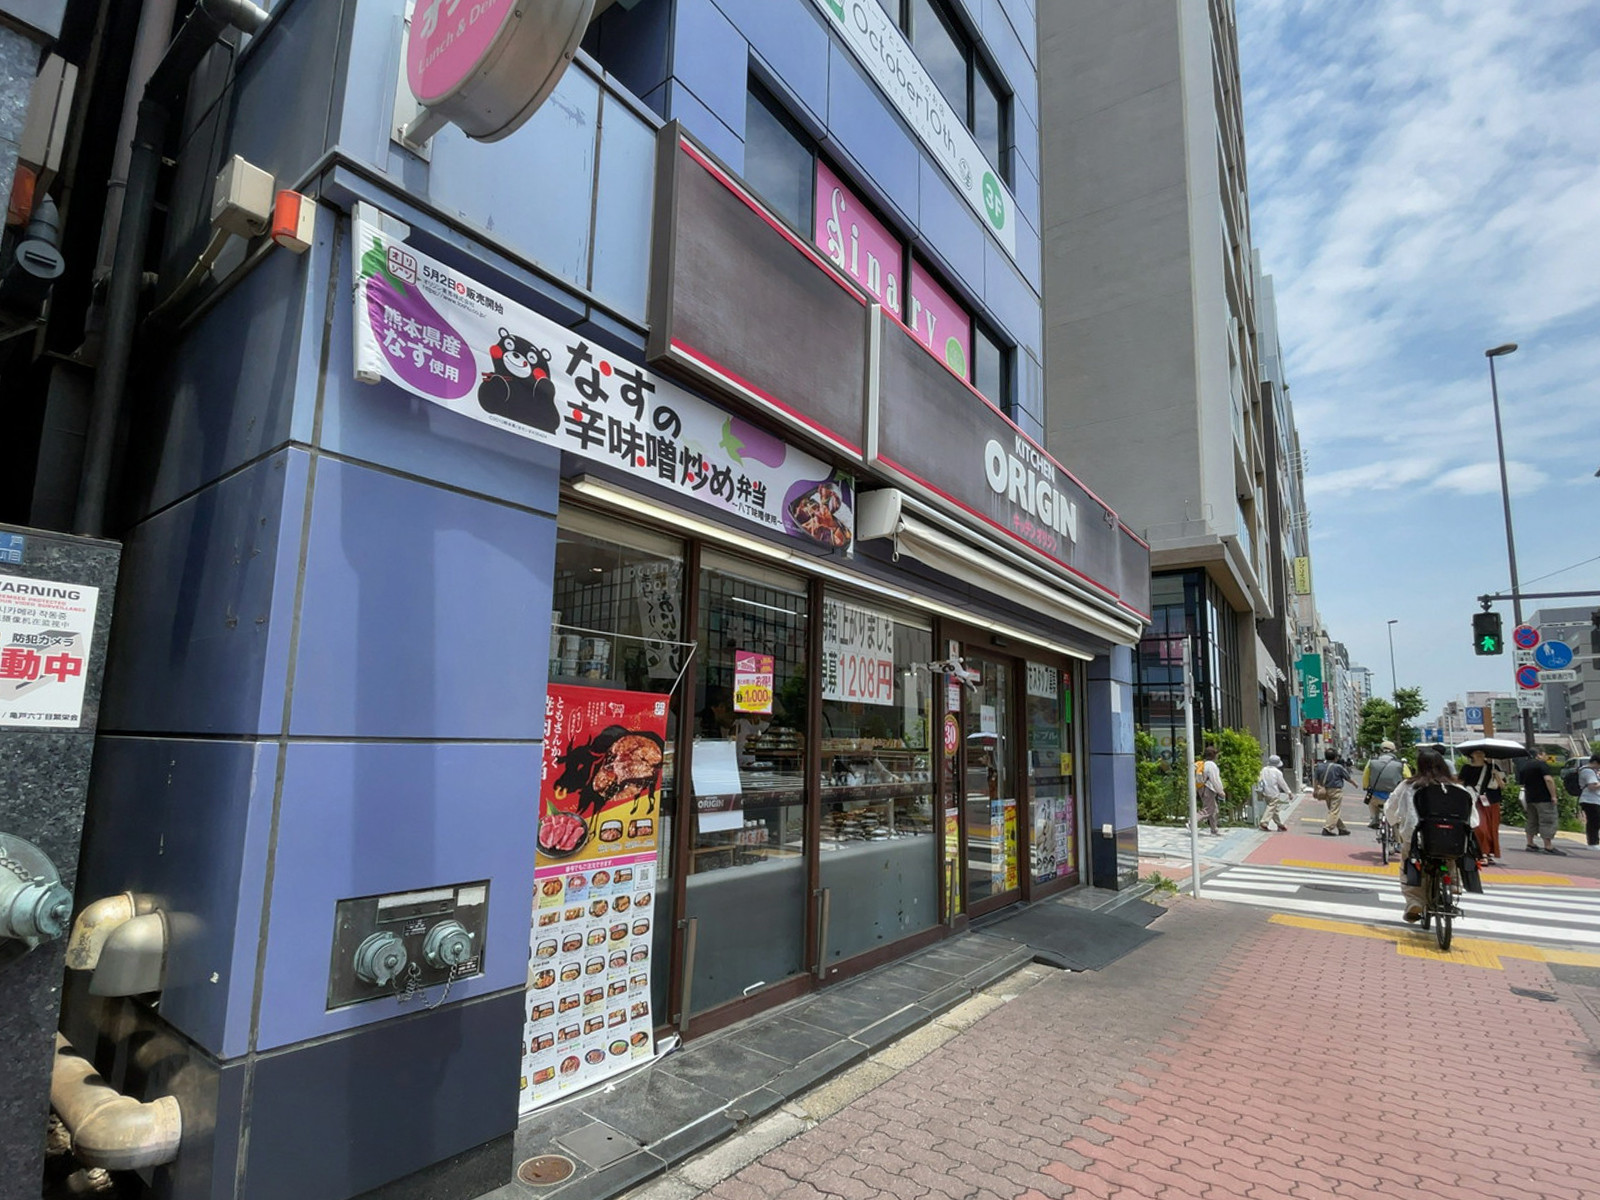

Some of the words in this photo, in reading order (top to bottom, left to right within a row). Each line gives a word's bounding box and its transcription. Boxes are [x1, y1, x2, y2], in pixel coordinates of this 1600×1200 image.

[418, 31, 454, 75] Lunch
[456, 18, 466, 37] &
[984, 182, 1003, 218] 3F
[383, 304, 461, 358] 熊本県産
[565, 341, 682, 439] なすの
[1015, 435, 1056, 483] KITCHEN
[985, 439, 1077, 545] ORIGIN
[0, 582, 80, 600] ARNING
[12, 632, 75, 648] 防犯カメラ
[1307, 674, 1320, 697] Ash
